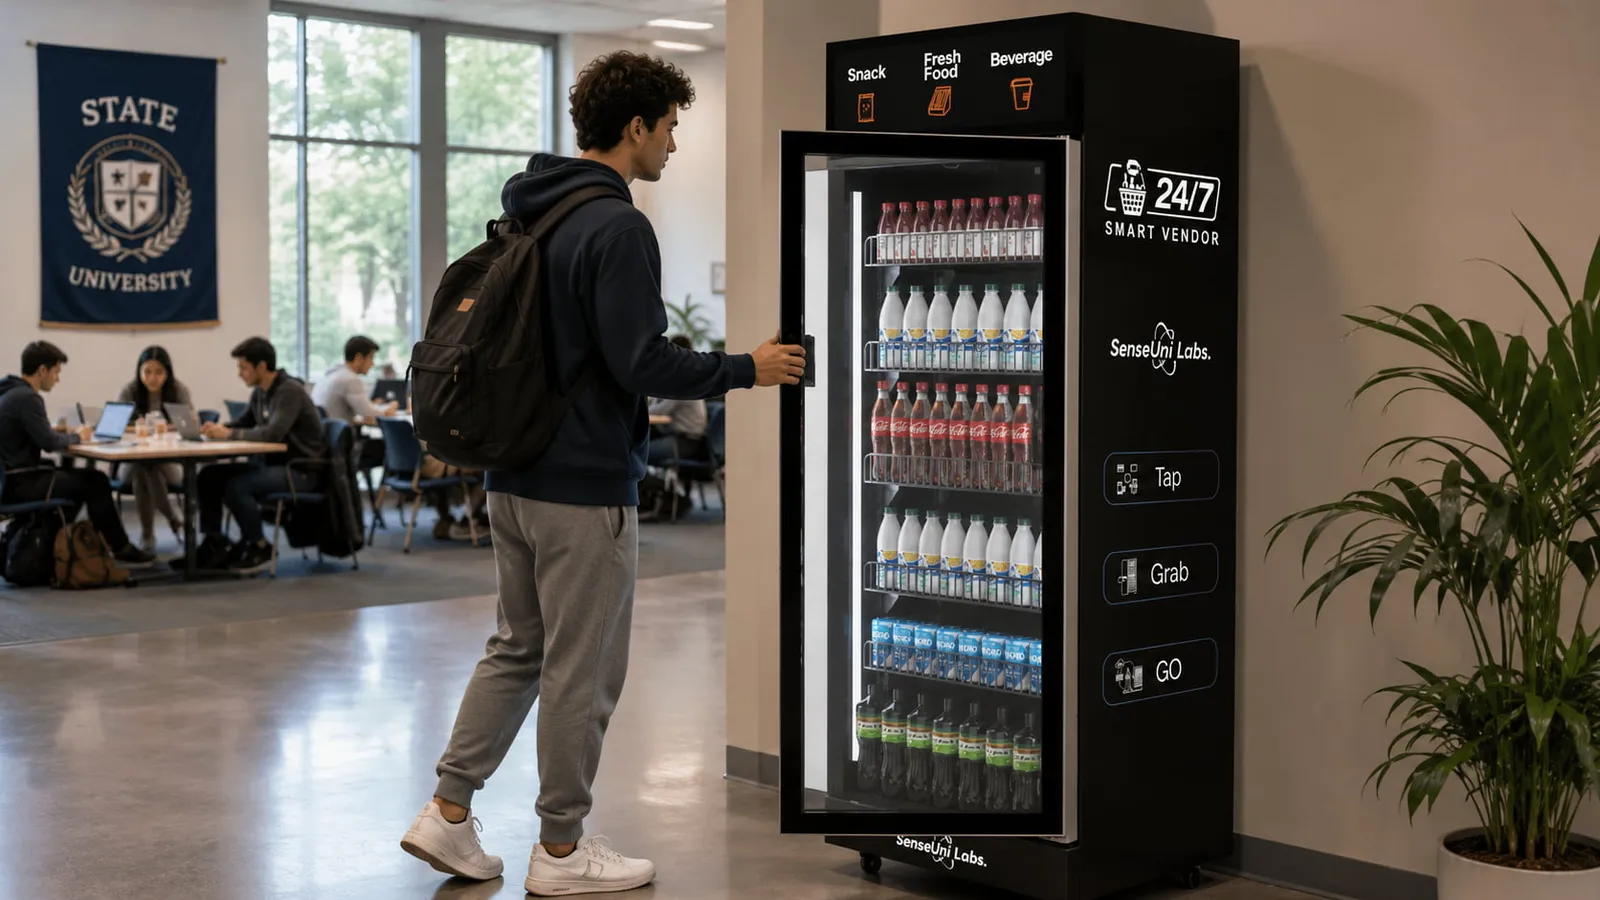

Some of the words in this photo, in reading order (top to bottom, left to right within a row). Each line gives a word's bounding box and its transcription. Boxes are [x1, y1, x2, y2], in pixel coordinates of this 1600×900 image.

[924, 49, 961, 67] Fresh
[990, 50, 1053, 67] Beverage
[848, 64, 887, 82] Snack
[924, 63, 958, 81] Food
[81, 96, 178, 133] STATE
[1154, 177, 1215, 213] 24/7
[1105, 221, 1155, 239] SMART
[1161, 227, 1219, 246] VENDOR
[69, 265, 192, 292] UNIVERSITY
[1110, 338, 1173, 359] SenseUni
[1177, 341, 1211, 360] Labs.
[1155, 467, 1182, 491] Tap
[1150, 561, 1189, 585] Grab
[1156, 658, 1182, 683] GO
[896, 835, 951, 858] SenseUni
[954, 846, 988, 868] Labs.
